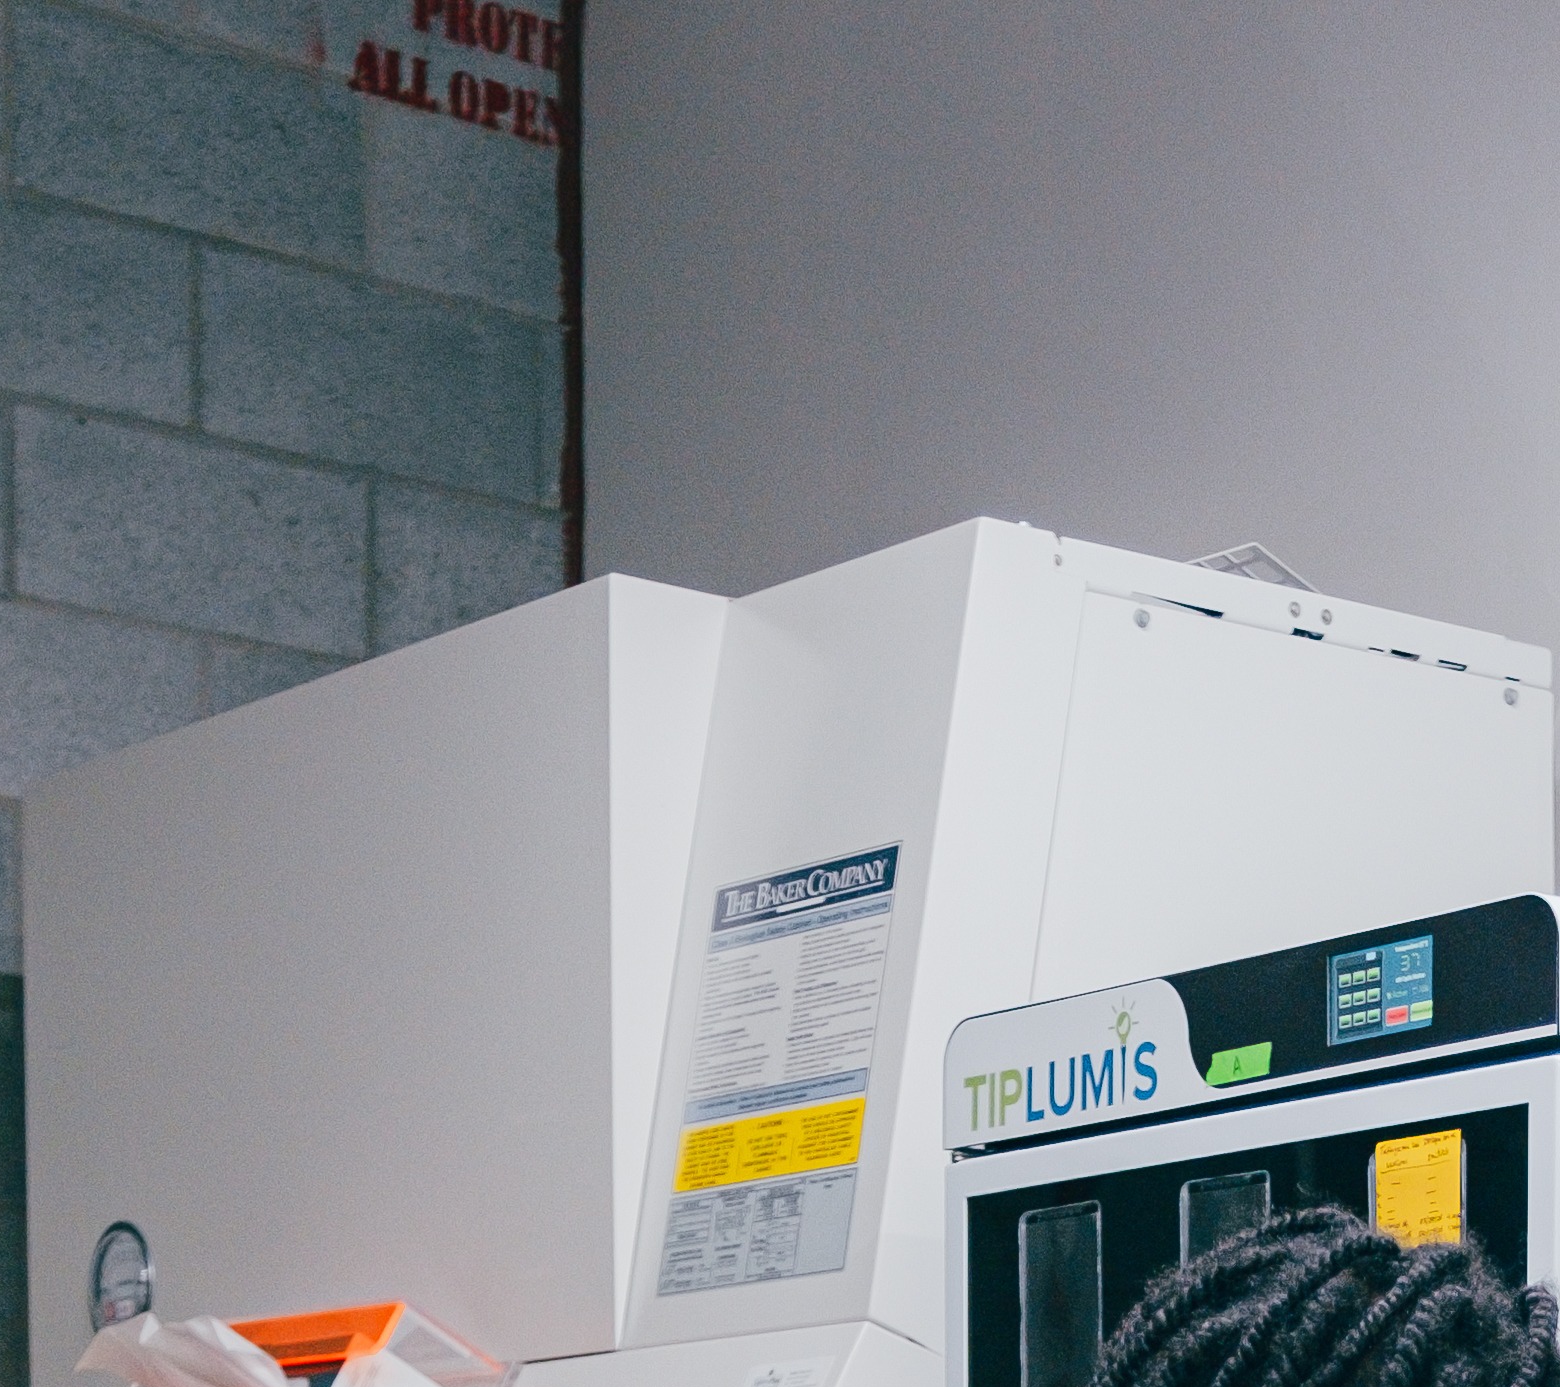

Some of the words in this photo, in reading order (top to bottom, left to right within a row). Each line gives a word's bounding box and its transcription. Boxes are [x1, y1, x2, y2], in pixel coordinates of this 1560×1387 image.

[348, 38, 438, 115] ALL
[724, 888, 756, 918] THE
[755, 878, 808, 911] BAKER
[806, 858, 889, 897] COMPANY
[1400, 951, 1421, 972] 37
[963, 1036, 1159, 1132] TIPLUMIS
[1231, 1054, 1242, 1076] A
